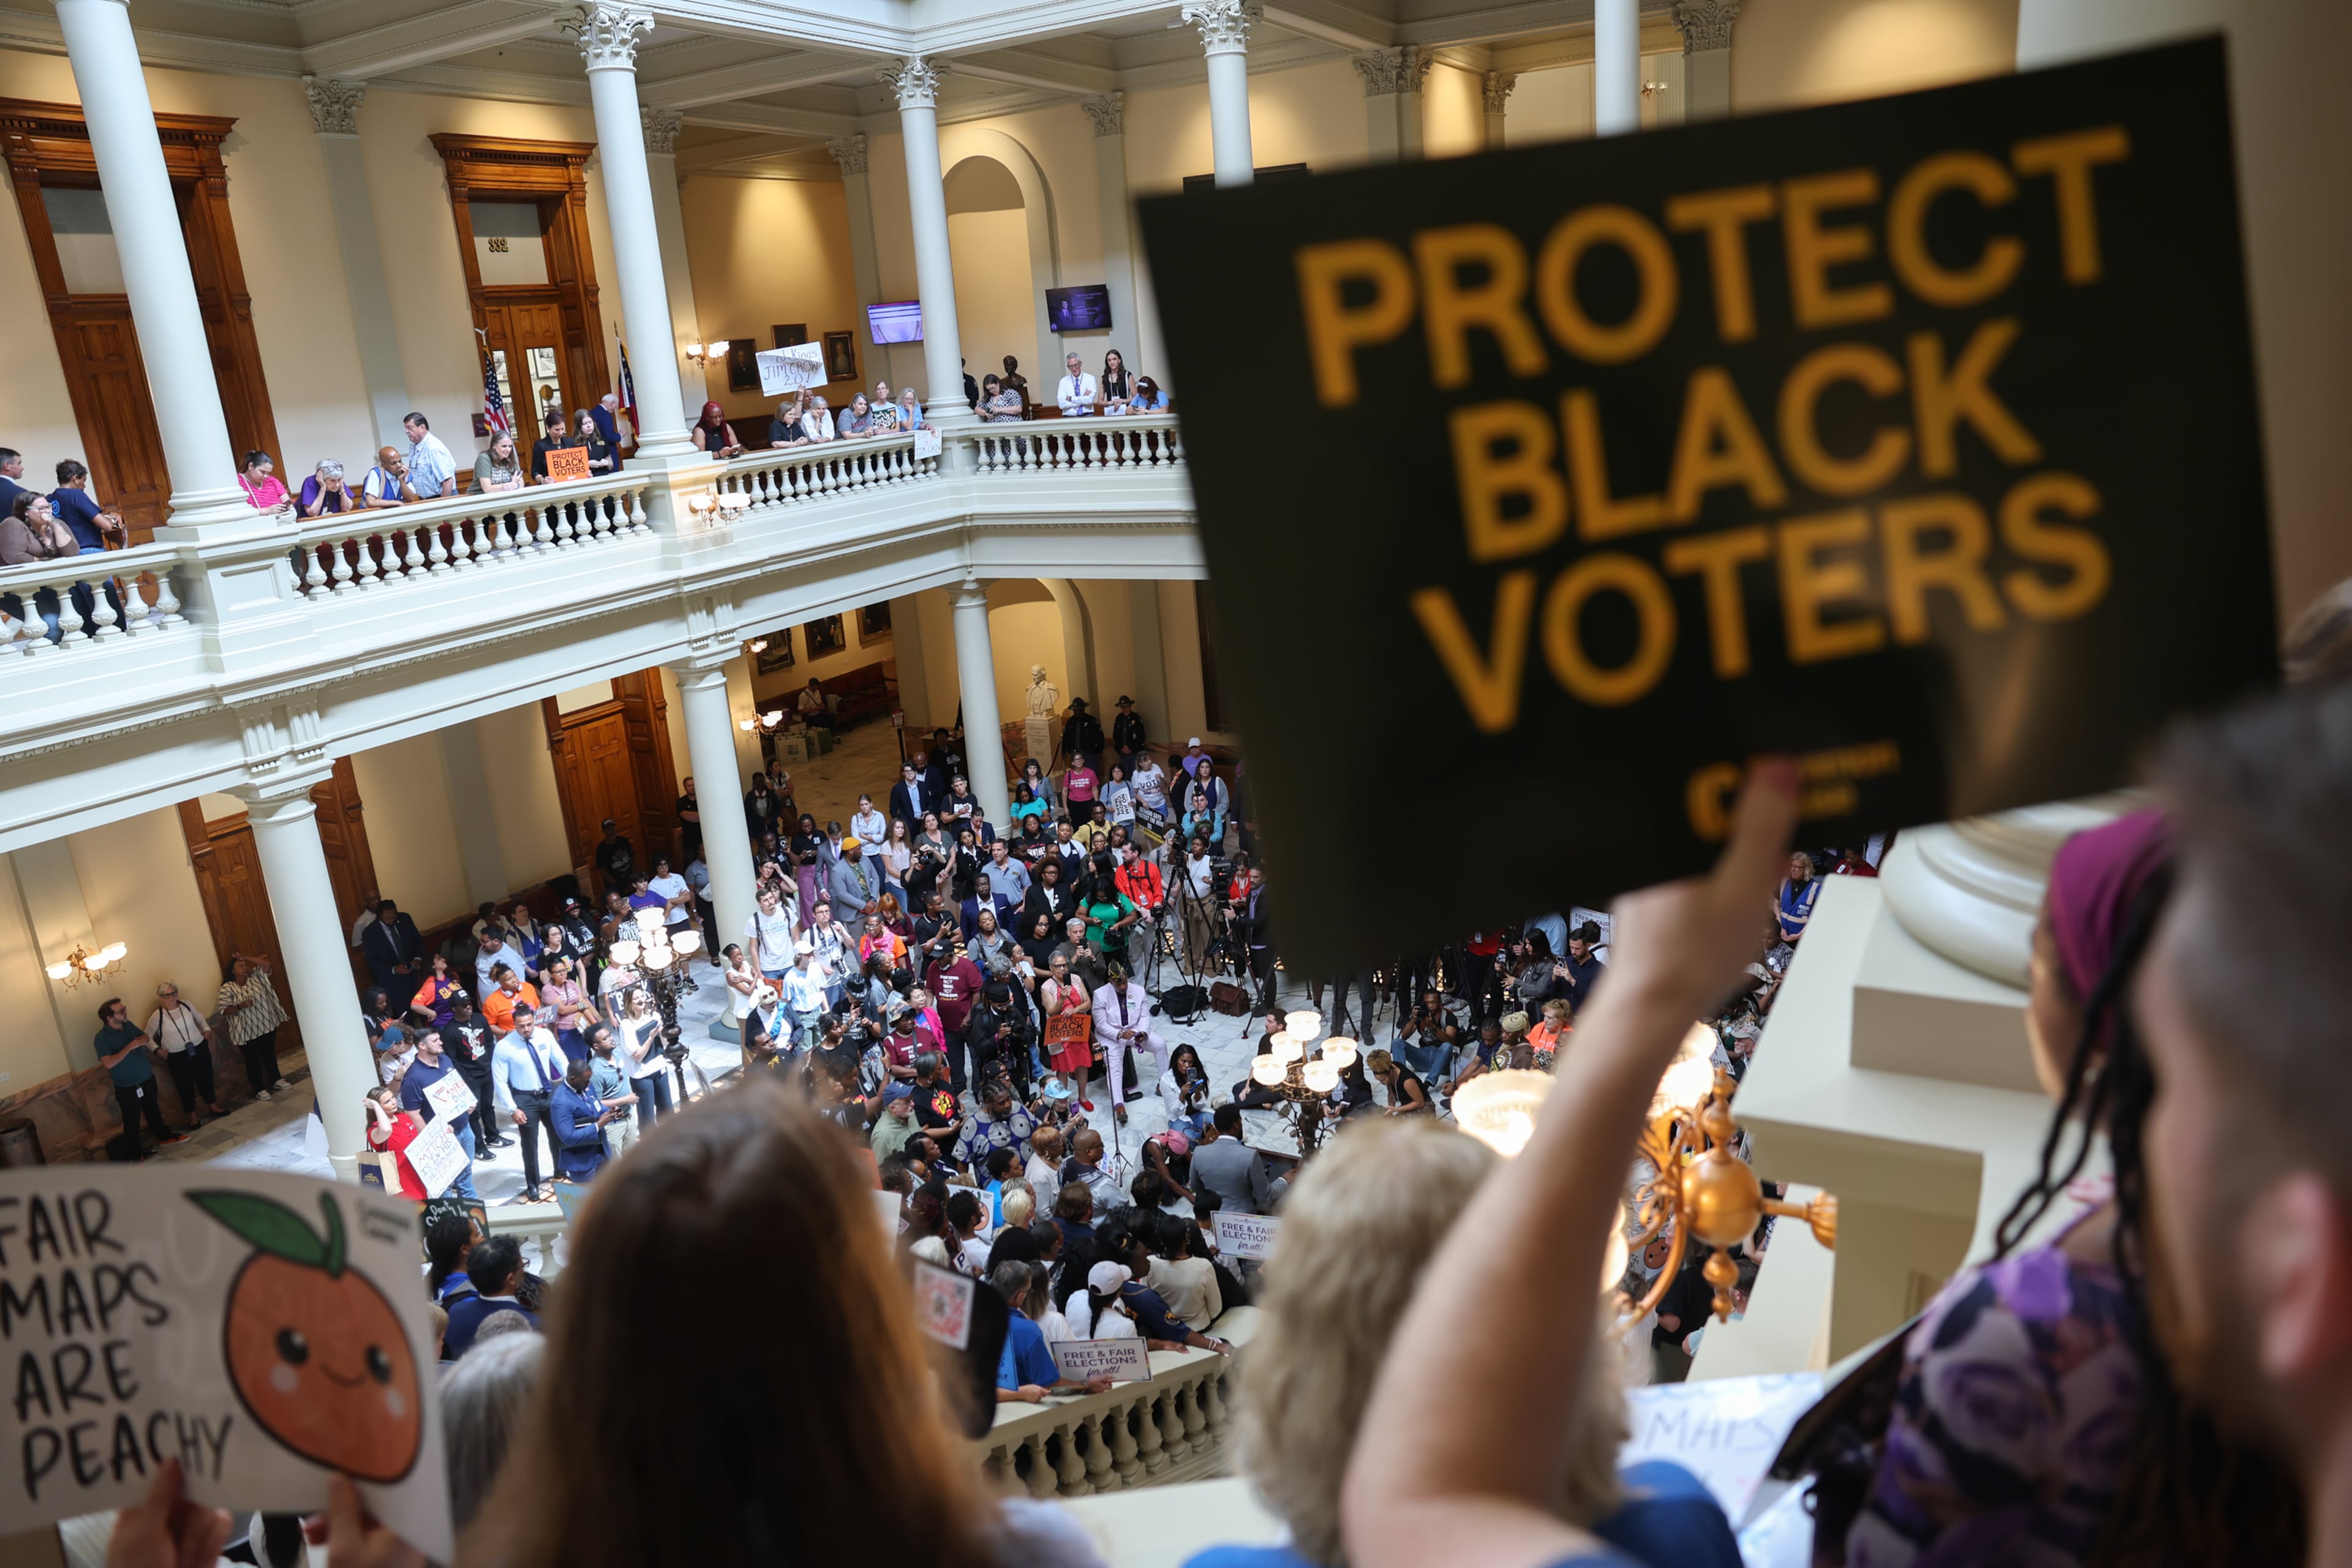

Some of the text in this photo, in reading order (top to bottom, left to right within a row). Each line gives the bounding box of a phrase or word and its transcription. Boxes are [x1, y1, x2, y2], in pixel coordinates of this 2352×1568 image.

[488, 237, 509, 252] 332
[1295, 124, 2130, 407] PROTECT
[764, 360, 818, 380] JIM CROW
[1449, 318, 2043, 562] BLACK
[552, 451, 582, 460] PROTECT
[553, 457, 584, 469] BLACK
[554, 466, 586, 477] VOTERS
[1411, 472, 2114, 736] VOTERS
[1140, 777, 1161, 789] VOTE
[1121, 794, 1126, 804] NO
[1050, 1022, 1084, 1032] BLACK
[1050, 1030, 1084, 1038] VOTERS
[0, 1189, 127, 1267] FAIR
[1222, 1223, 1245, 1232] FREE
[1256, 1227, 1277, 1235] FAIR
[1223, 1230, 1275, 1243] ELECTION
[1238, 1241, 1250, 1250] for
[1, 1262, 170, 1340] MAPS
[1064, 1351, 1094, 1360] FREE
[1109, 1348, 1136, 1357] FAIR
[1065, 1356, 1137, 1368] ELECTIONS
[1086, 1365, 1121, 1378] for all!
[13, 1340, 140, 1423] ARE
[21, 1411, 233, 1502] PEACHY
